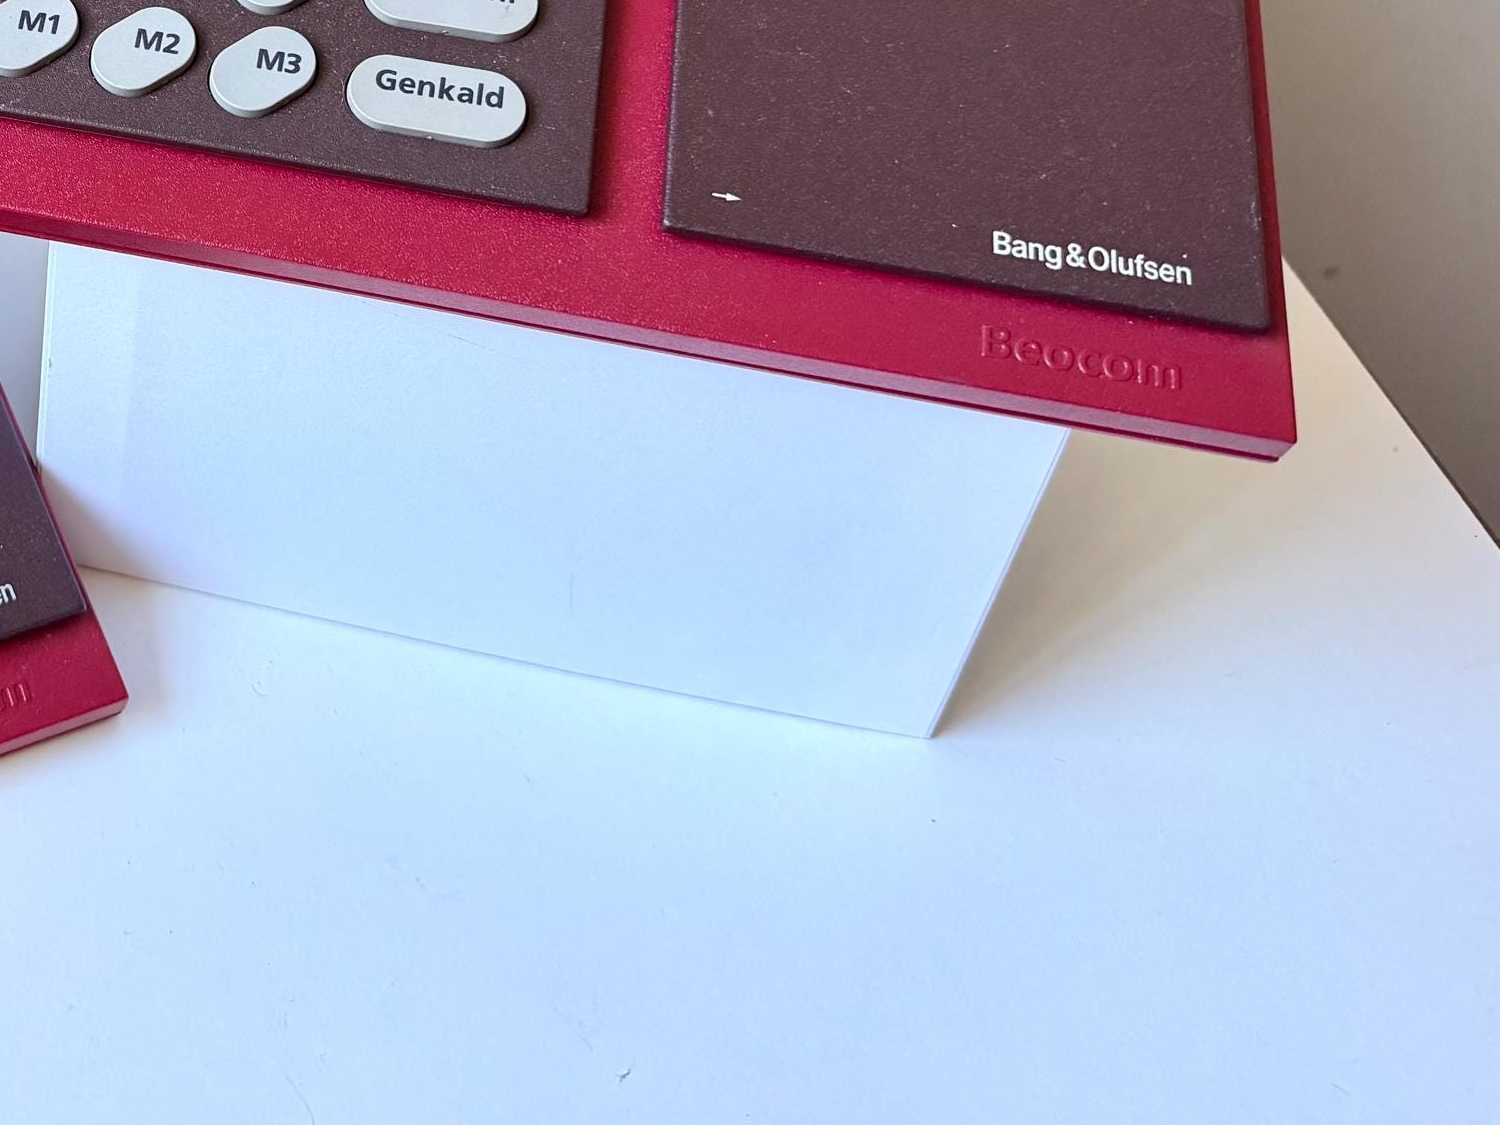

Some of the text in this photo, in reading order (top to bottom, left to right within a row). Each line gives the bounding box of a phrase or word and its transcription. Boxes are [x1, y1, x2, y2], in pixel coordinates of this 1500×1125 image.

[18, 10, 60, 34] M1
[135, 28, 180, 54] M2
[257, 49, 301, 73] M3
[375, 69, 505, 109] Genkald
[981, 325, 1182, 390] Beocom
